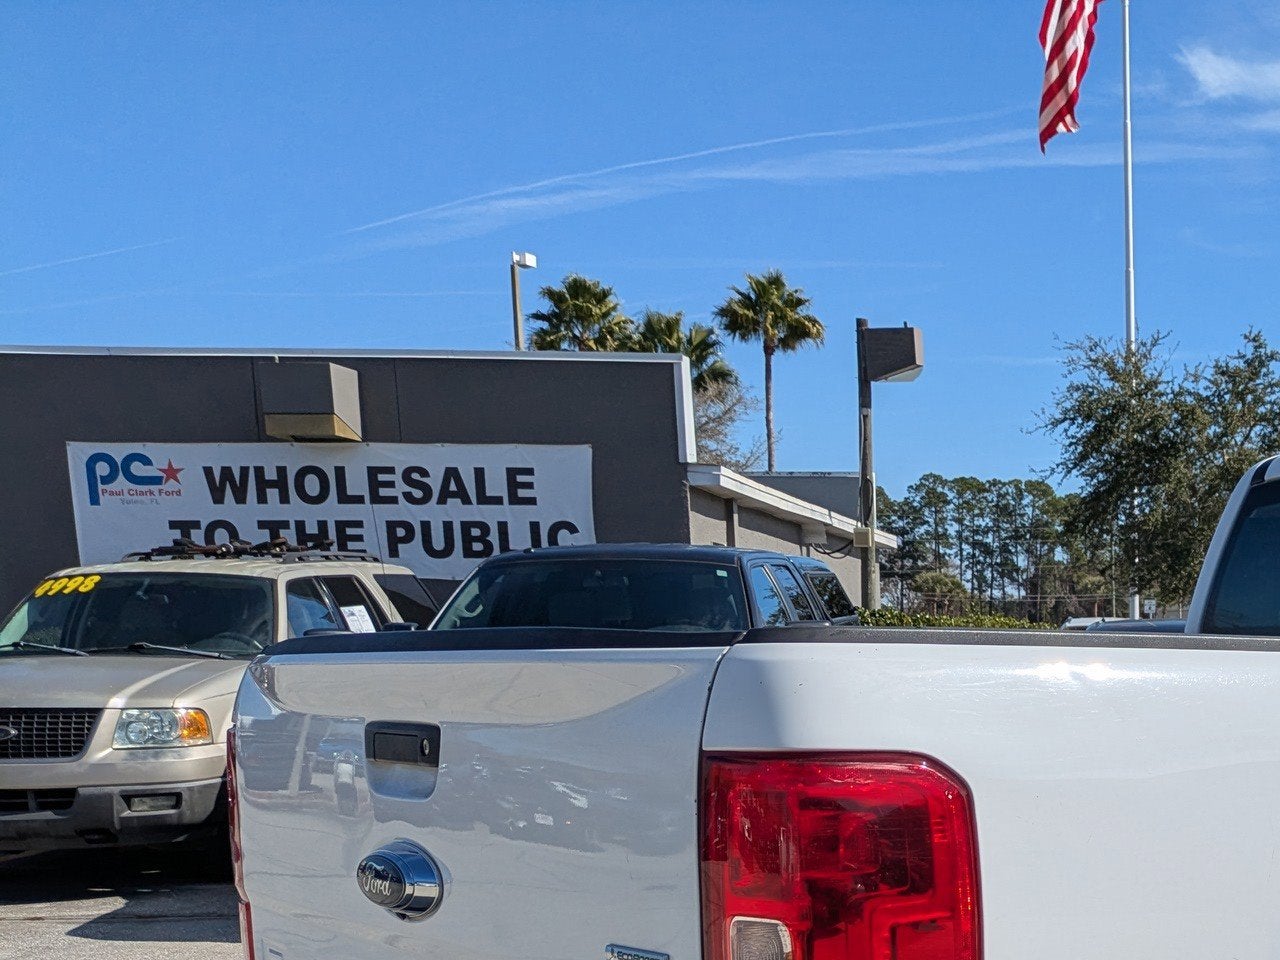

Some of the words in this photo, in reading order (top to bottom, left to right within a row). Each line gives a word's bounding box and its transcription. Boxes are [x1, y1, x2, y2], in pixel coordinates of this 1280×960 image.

[101, 488, 124, 497] Paul
[127, 488, 156, 497] Clark
[158, 488, 182, 497] Ford
[202, 465, 538, 506] WHOLESALE
[257, 519, 367, 554] THE
[385, 519, 580, 559] PUBLIC
[363, 861, 393, 896] Ford
